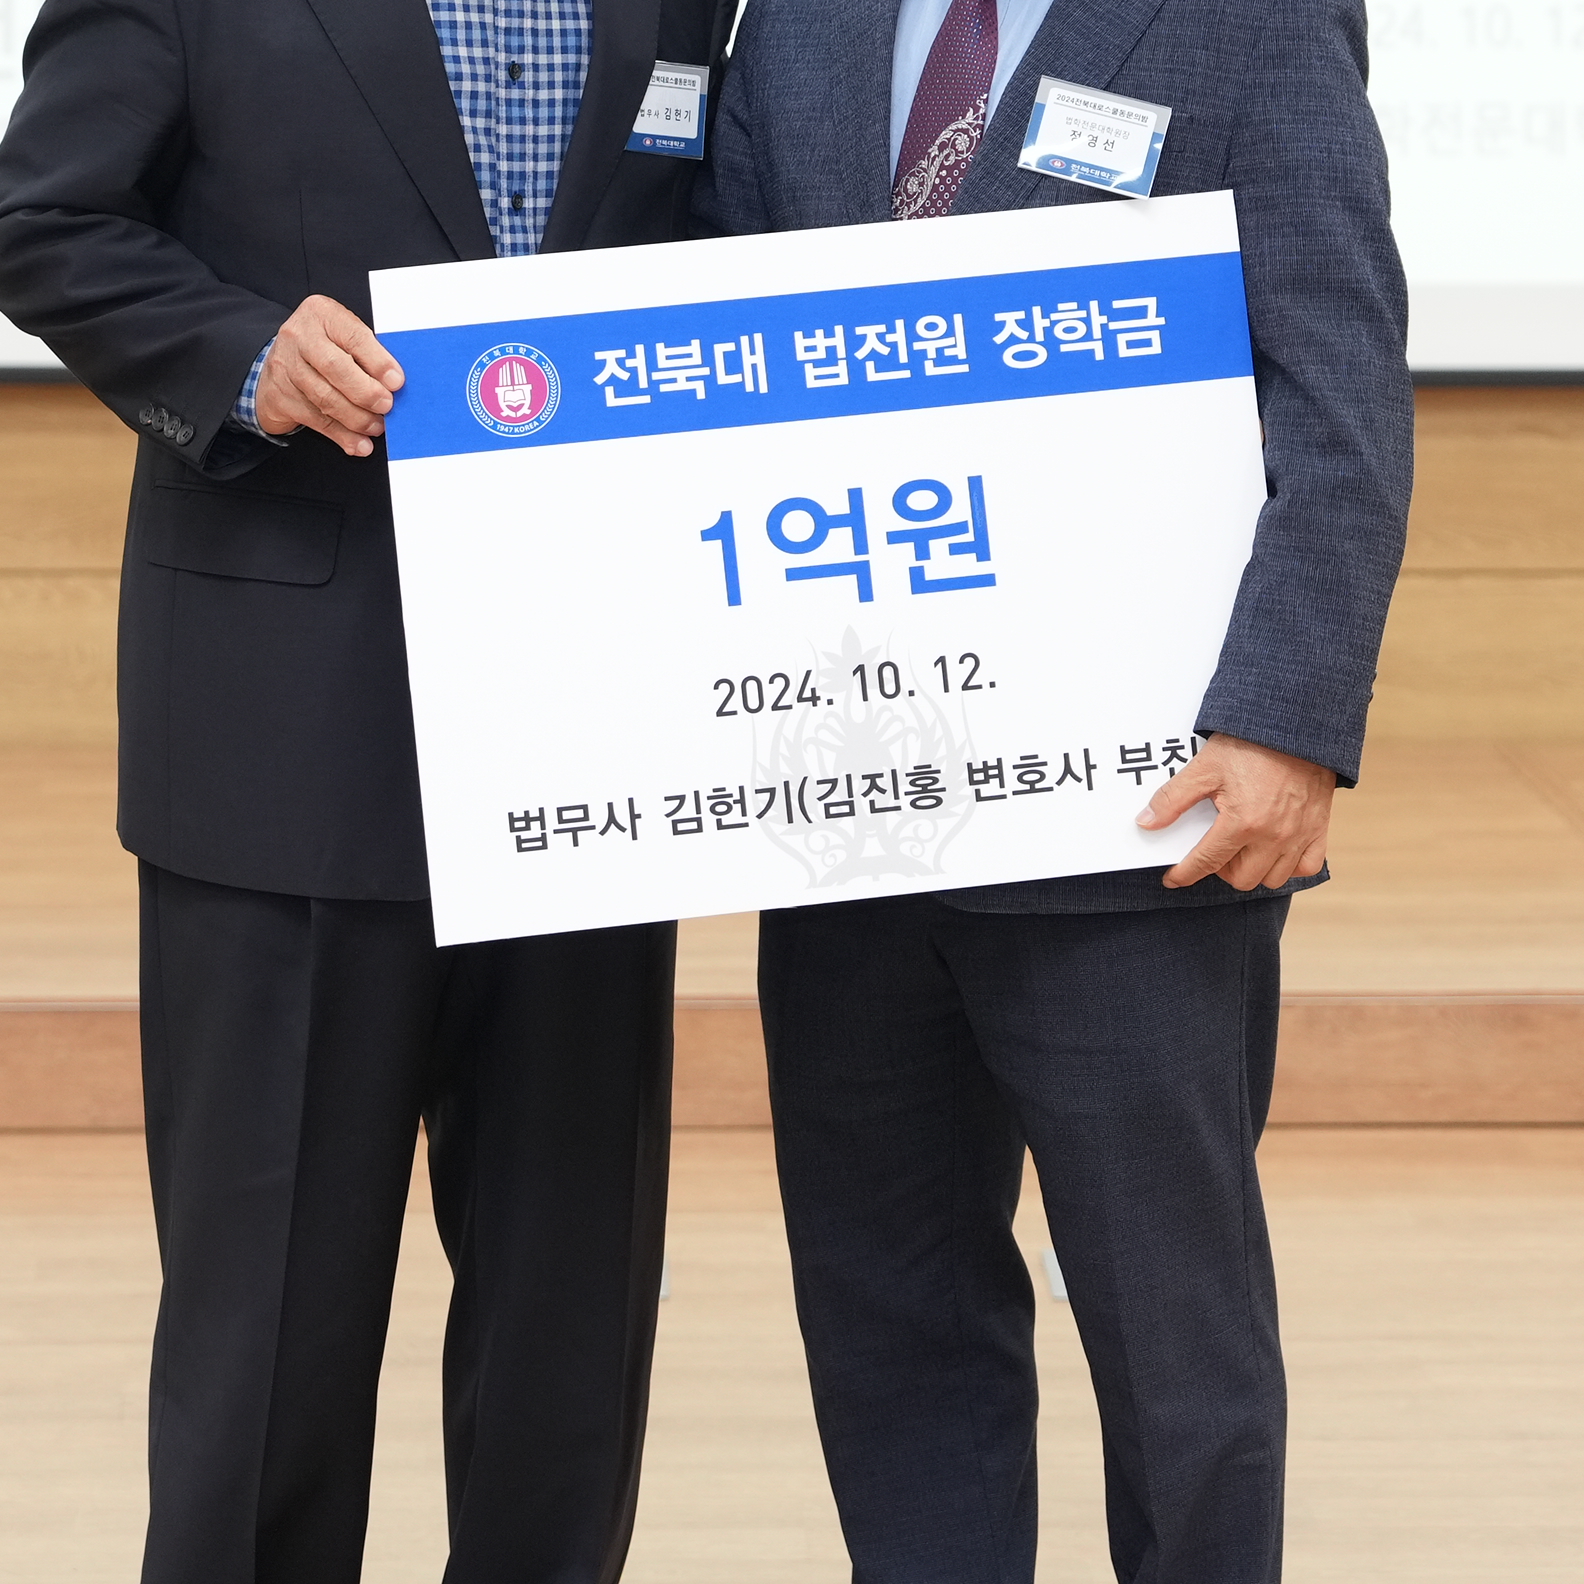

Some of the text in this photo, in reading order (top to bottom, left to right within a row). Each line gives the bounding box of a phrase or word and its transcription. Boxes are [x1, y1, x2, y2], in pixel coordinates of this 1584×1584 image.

[1460, 0, 1525, 52] 10.
[664, 107, 691, 123] 김헌기
[1056, 93, 1149, 123] 2024전북대로스쿨동문의밤
[1066, 116, 1131, 140] 법학전문대학원장
[482, 346, 539, 365] 전북대학교
[593, 297, 1166, 407] 전북대 법전원 장학금
[496, 421, 540, 434] 1947 KOREA
[700, 475, 997, 607] 1억원
[713, 652, 996, 718] 2024. 10. 12.
[507, 797, 642, 853] 법무사
[663, 764, 947, 836] 김헌기(김진홍
[966, 748, 1097, 803] 변호사
